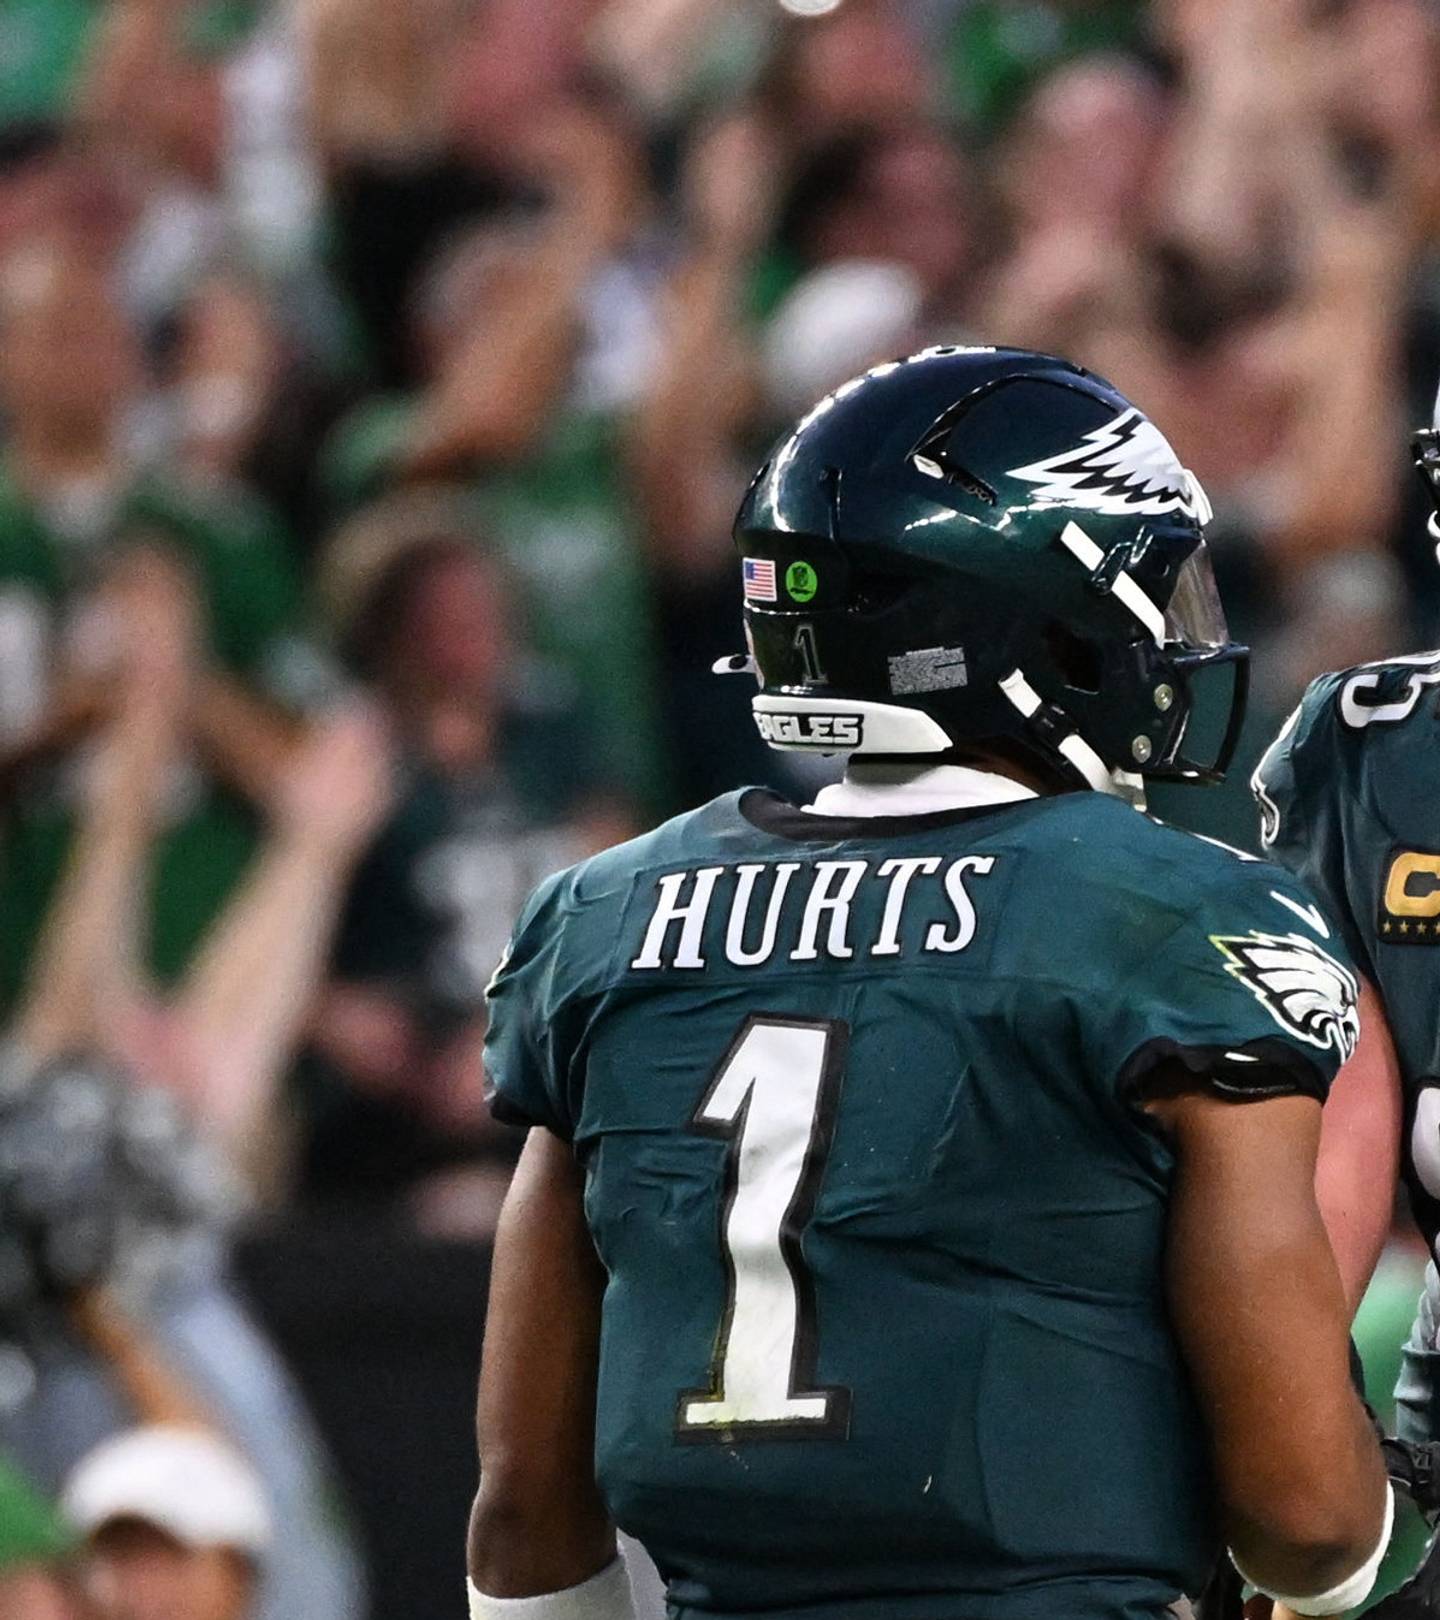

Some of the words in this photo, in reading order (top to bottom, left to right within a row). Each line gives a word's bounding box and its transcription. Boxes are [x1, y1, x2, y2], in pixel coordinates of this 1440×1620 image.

[794, 624, 829, 686] 1
[631, 856, 995, 970] HURTS
[684, 1022, 830, 1426] 1
